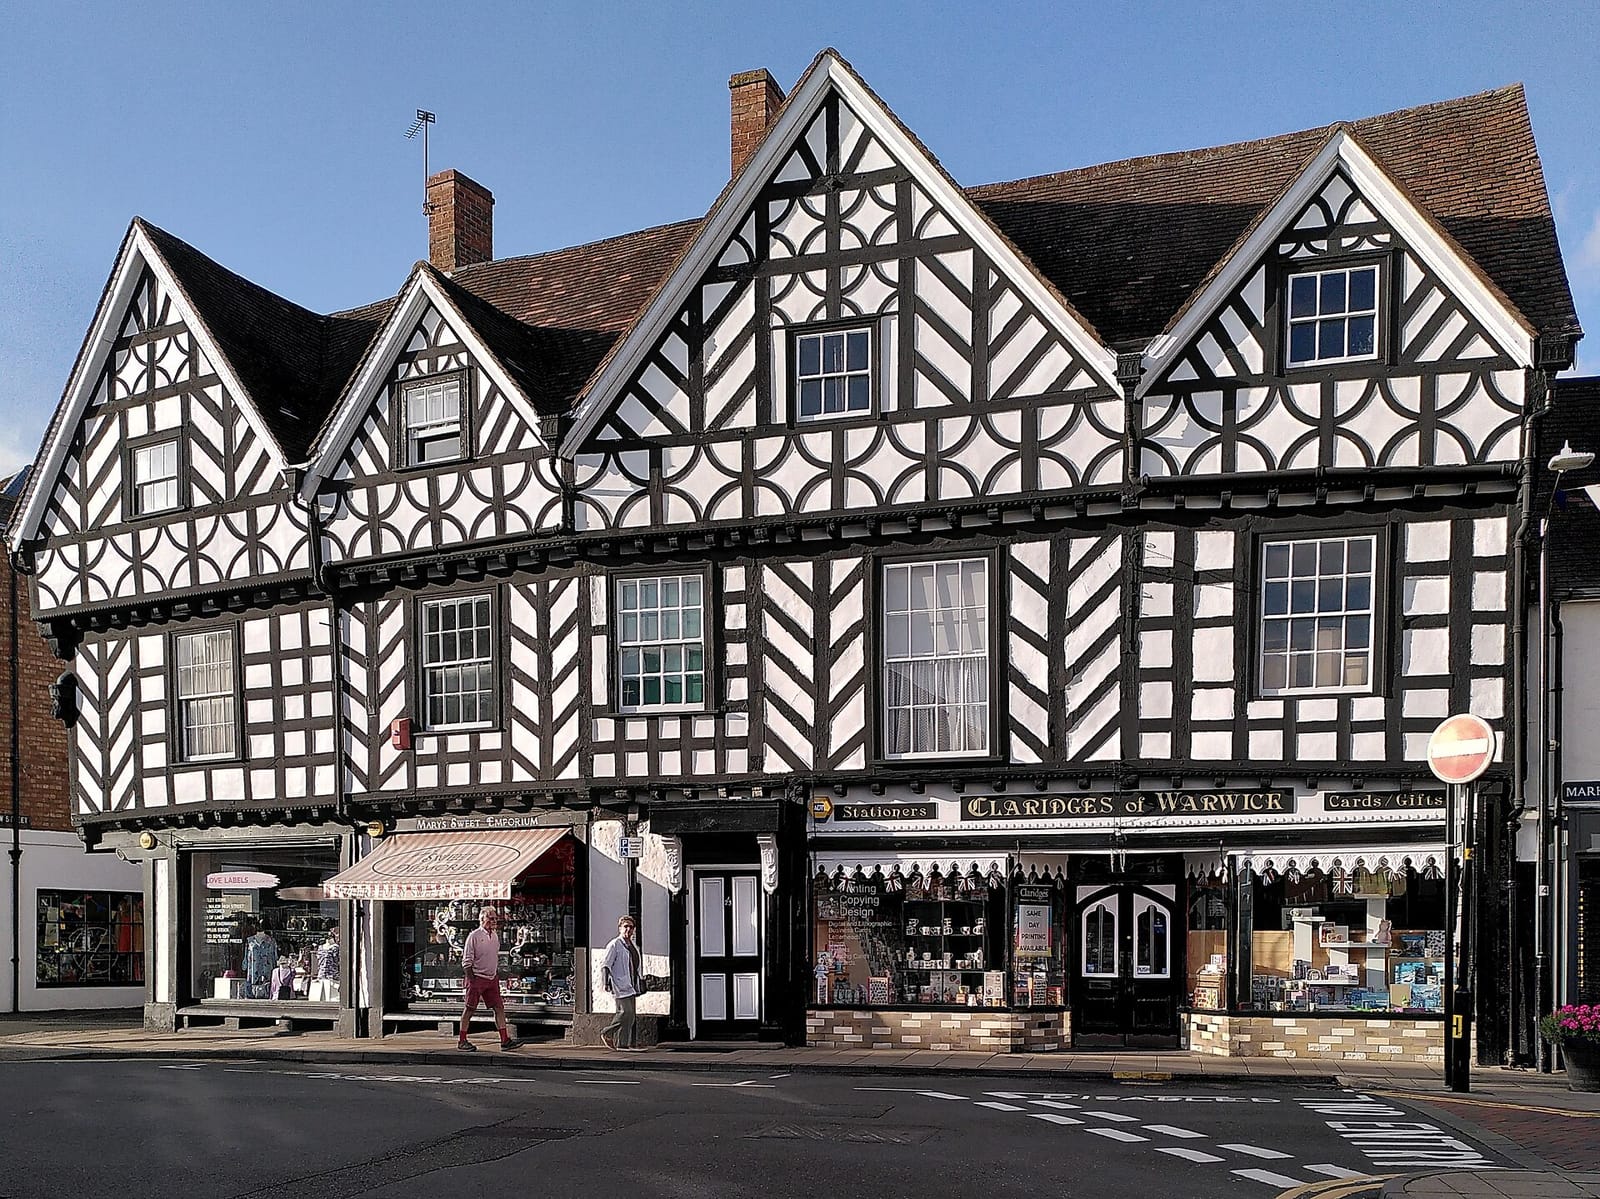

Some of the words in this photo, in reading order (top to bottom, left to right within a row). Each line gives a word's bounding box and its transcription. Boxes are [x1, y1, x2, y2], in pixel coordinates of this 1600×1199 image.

[967, 797, 1113, 817] CLARIDGES
[1125, 797, 1145, 813] of
[1155, 791, 1284, 812] WARWICK
[842, 805, 927, 818] Stationers
[416, 819, 447, 830] MARY'S
[450, 817, 480, 829] SWEET
[486, 815, 539, 828] EMPORIUM
[840, 895, 880, 907] Copying
[840, 908, 874, 919] Design
